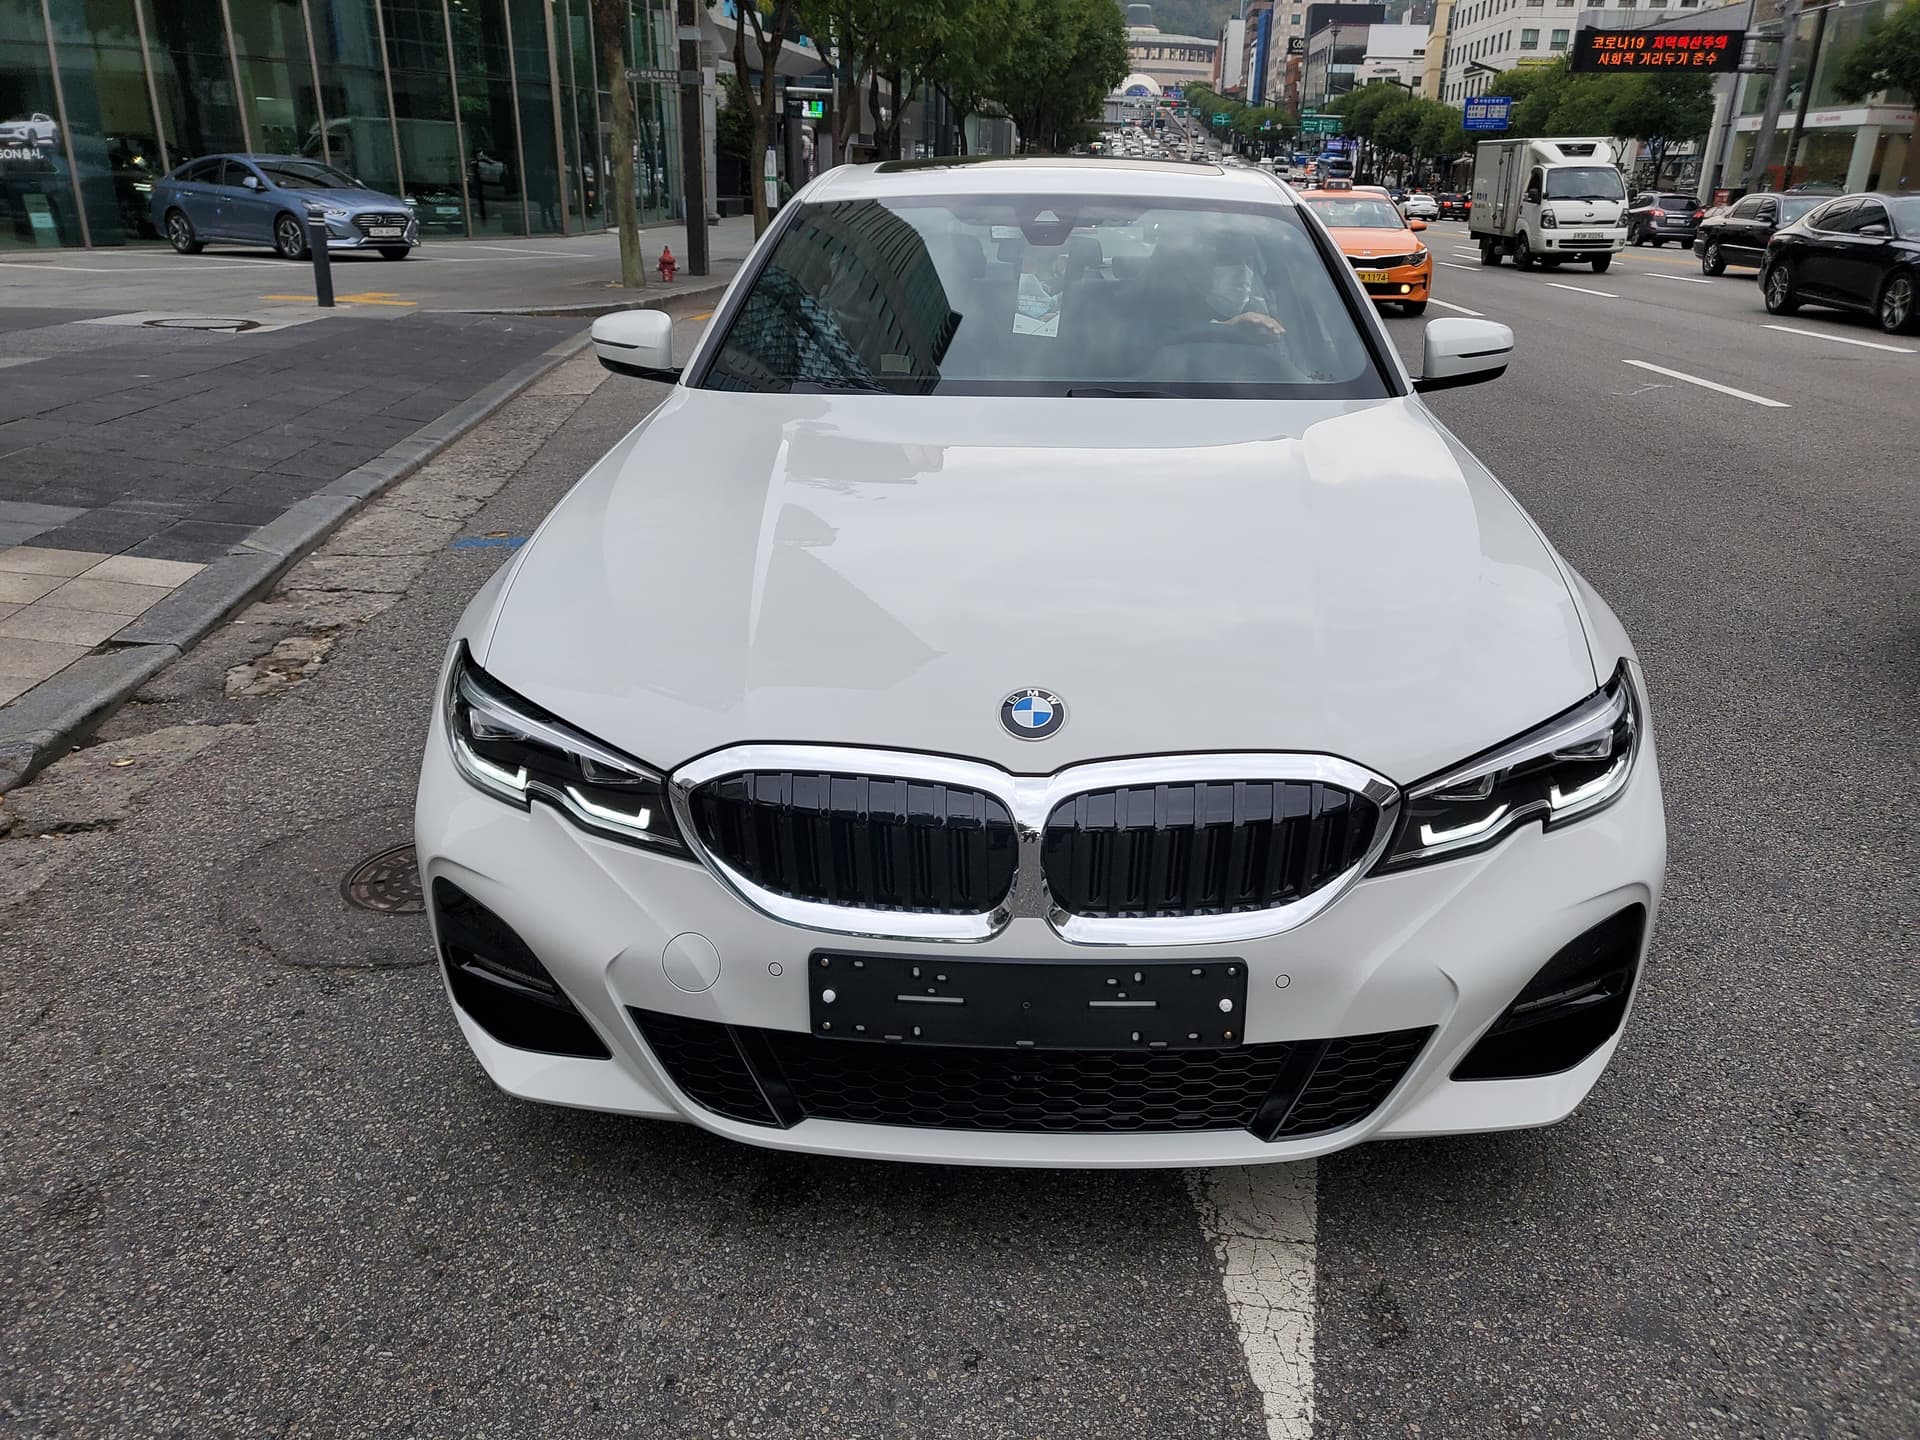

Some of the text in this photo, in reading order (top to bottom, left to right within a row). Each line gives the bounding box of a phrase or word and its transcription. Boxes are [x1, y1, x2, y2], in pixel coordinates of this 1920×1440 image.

[1592, 36, 1646, 49] 코로나19
[1597, 52, 1718, 65] 사회적 거리두기 준수
[1007, 690, 1060, 704] BMW
